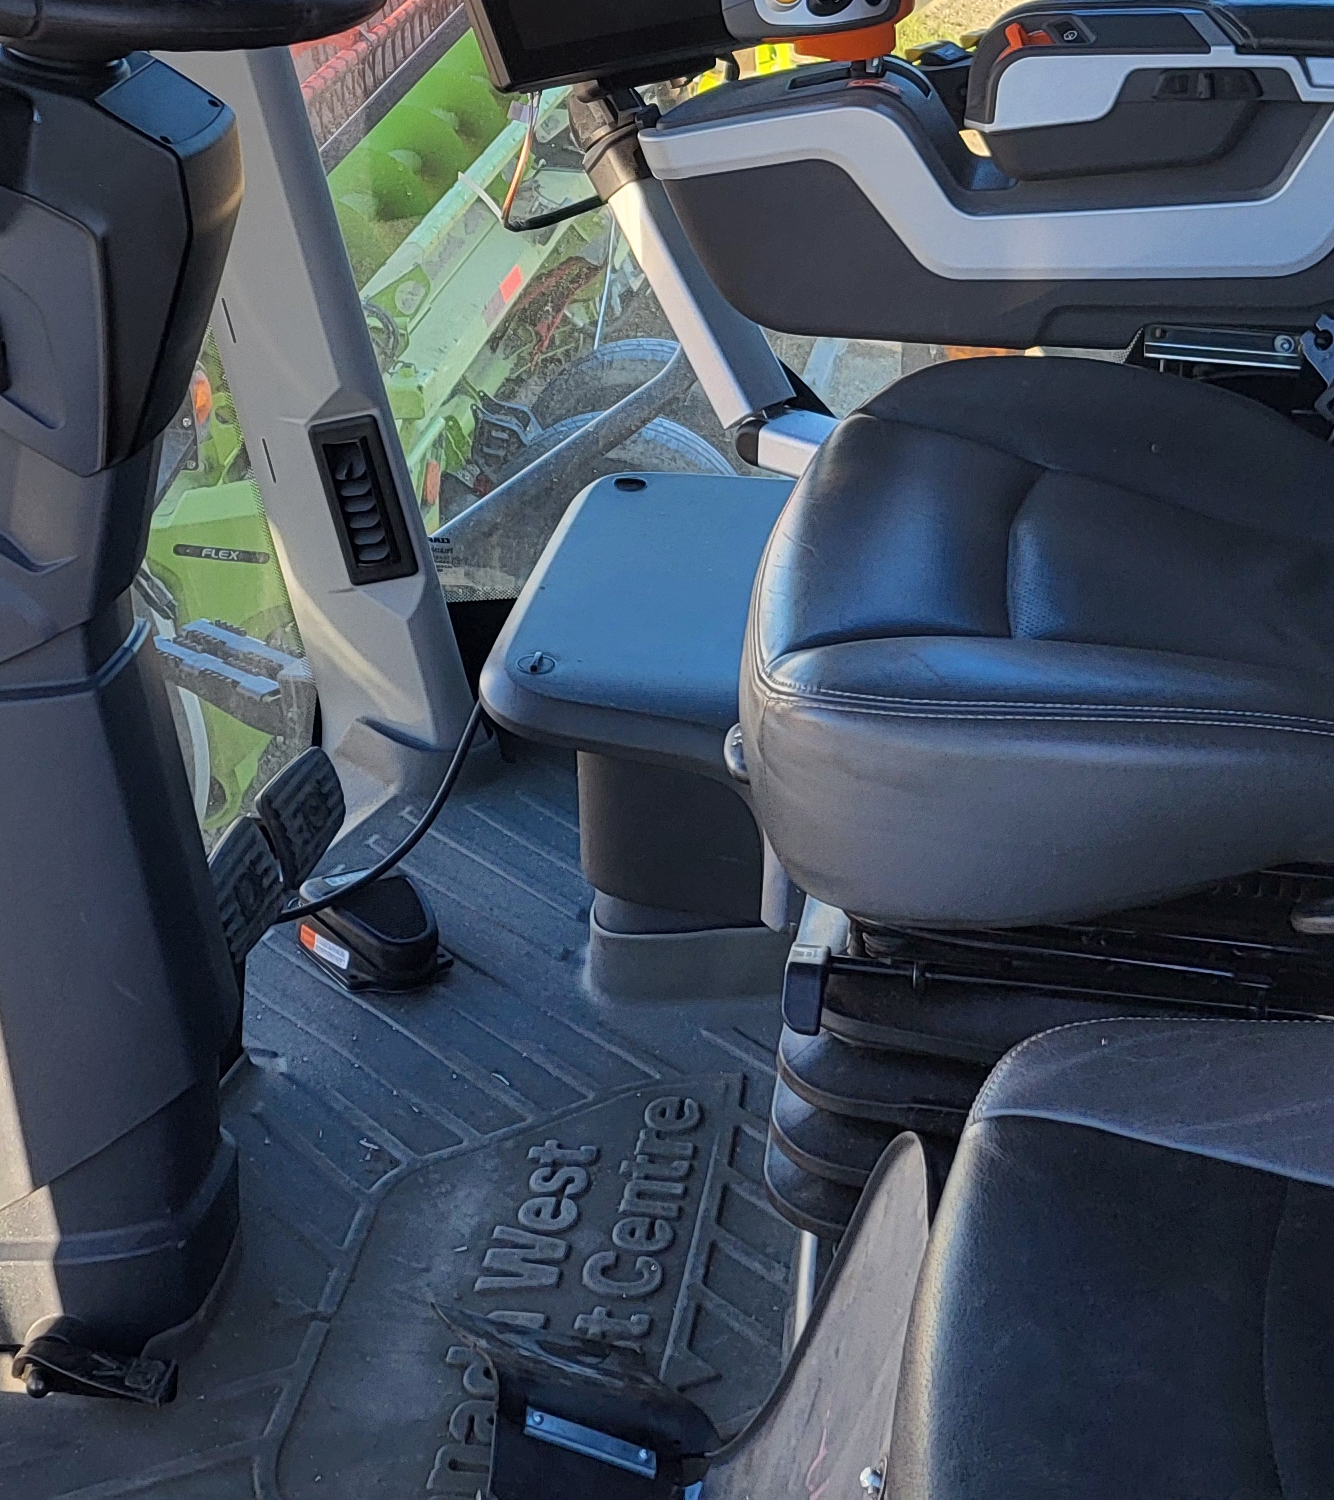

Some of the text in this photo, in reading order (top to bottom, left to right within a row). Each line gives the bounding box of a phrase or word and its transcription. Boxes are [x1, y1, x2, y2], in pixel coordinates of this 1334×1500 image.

[201, 548, 240, 561] FLEX
[473, 1138, 599, 1293] West
[581, 1095, 701, 1297] Centre
